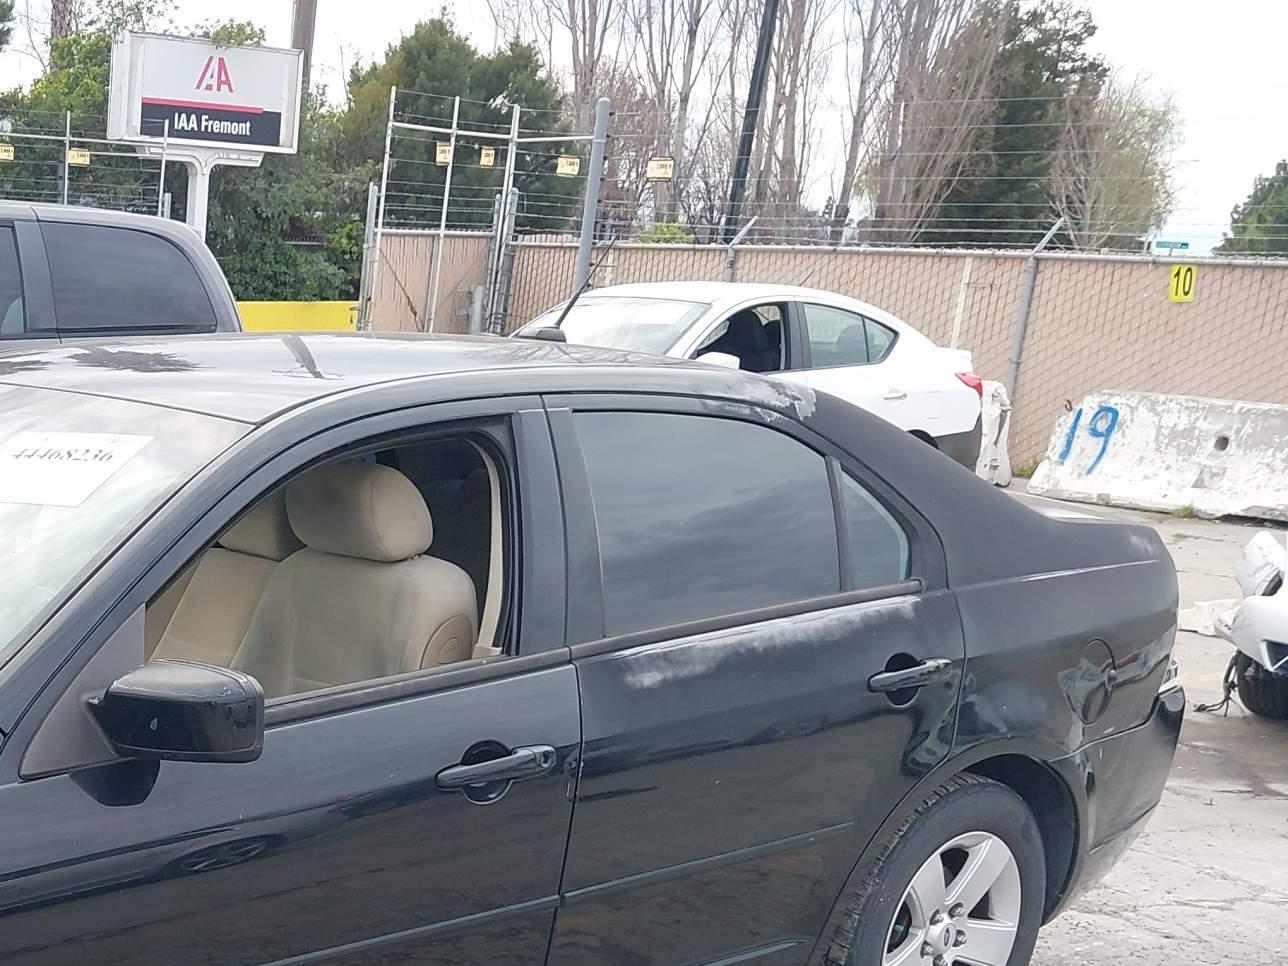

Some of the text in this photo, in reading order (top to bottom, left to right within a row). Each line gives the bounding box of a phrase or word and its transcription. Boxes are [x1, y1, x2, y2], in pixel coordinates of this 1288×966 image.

[174, 112, 251, 136] IAA Fremont
[1173, 266, 1193, 297] 10
[1058, 406, 1119, 475] 19
